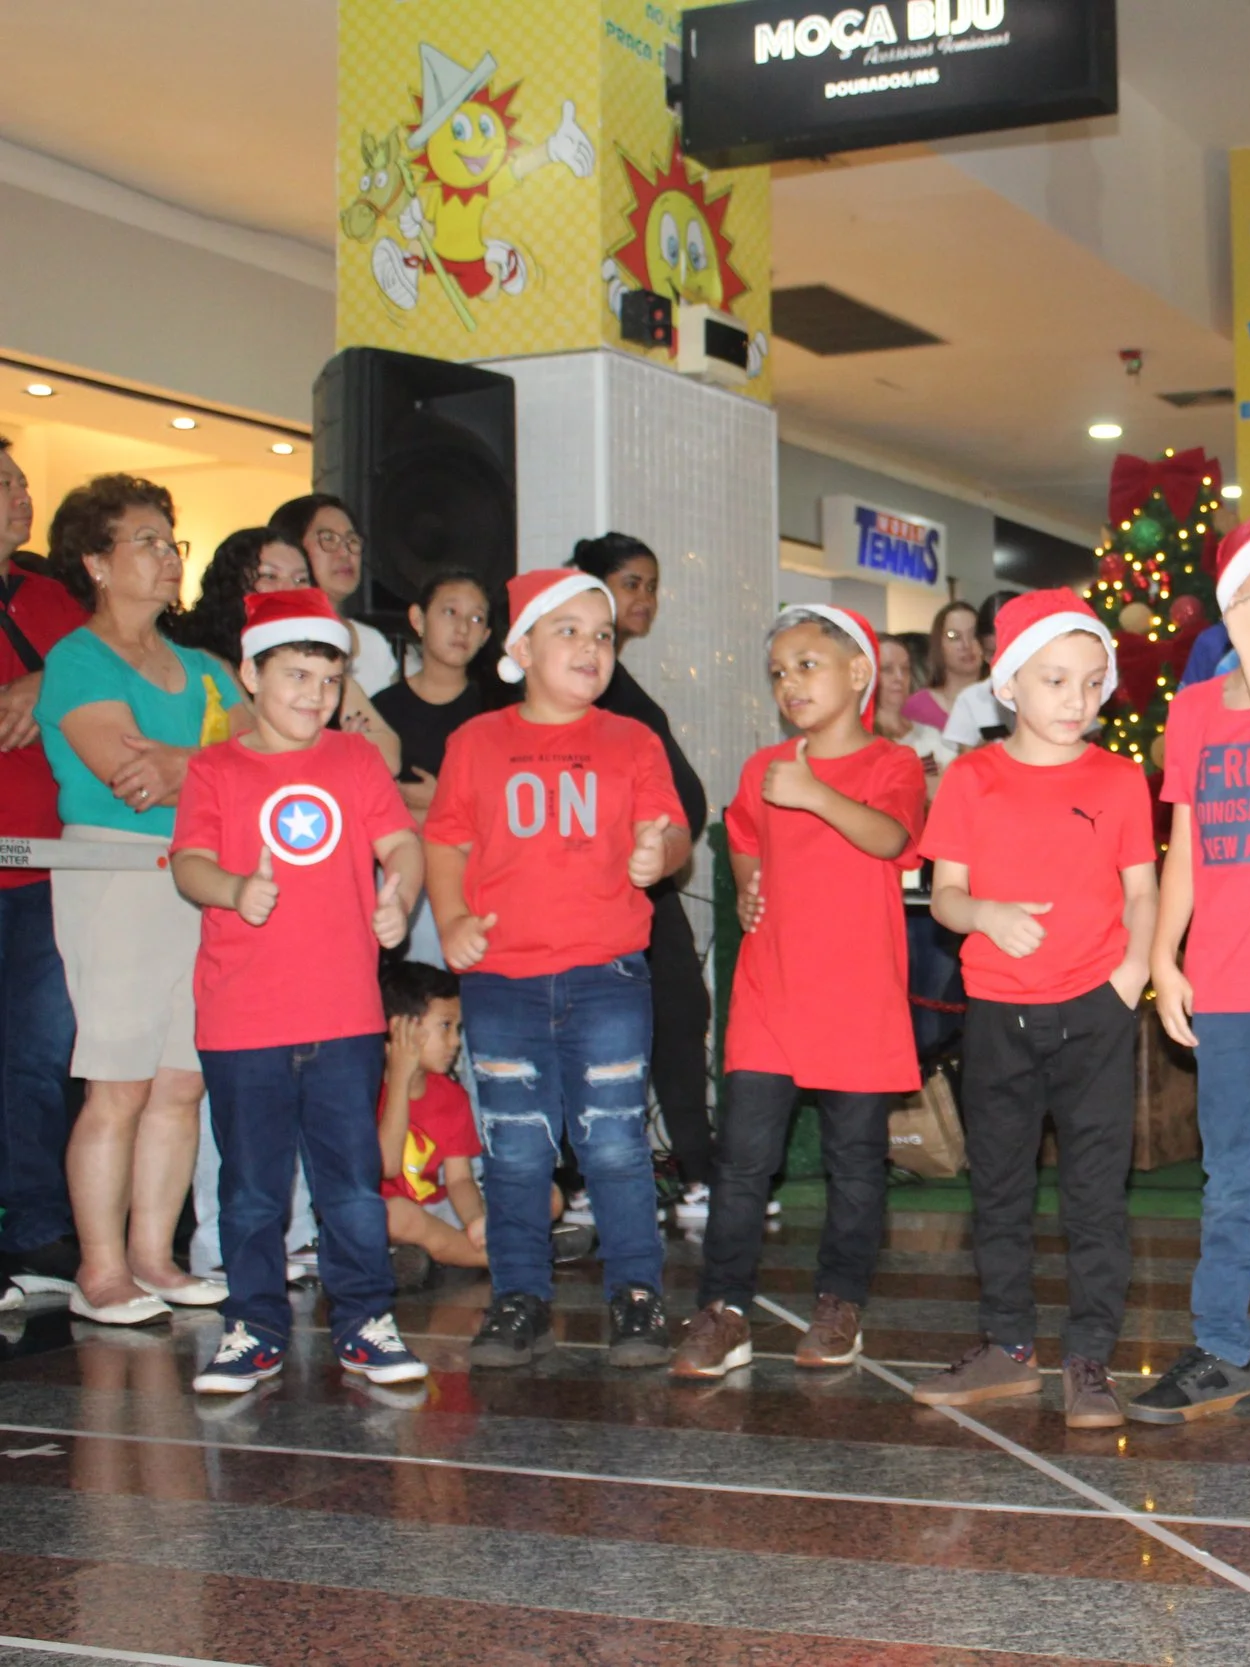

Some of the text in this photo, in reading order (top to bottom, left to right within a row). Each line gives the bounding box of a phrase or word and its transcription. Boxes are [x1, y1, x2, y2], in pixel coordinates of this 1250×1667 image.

[754, 0, 1005, 64] MOÇA BIJU
[824, 67, 940, 98] DOURADOS/MS
[855, 506, 939, 586] TENNIS
[505, 770, 598, 839] ON
[1203, 835, 1239, 860] NEW
